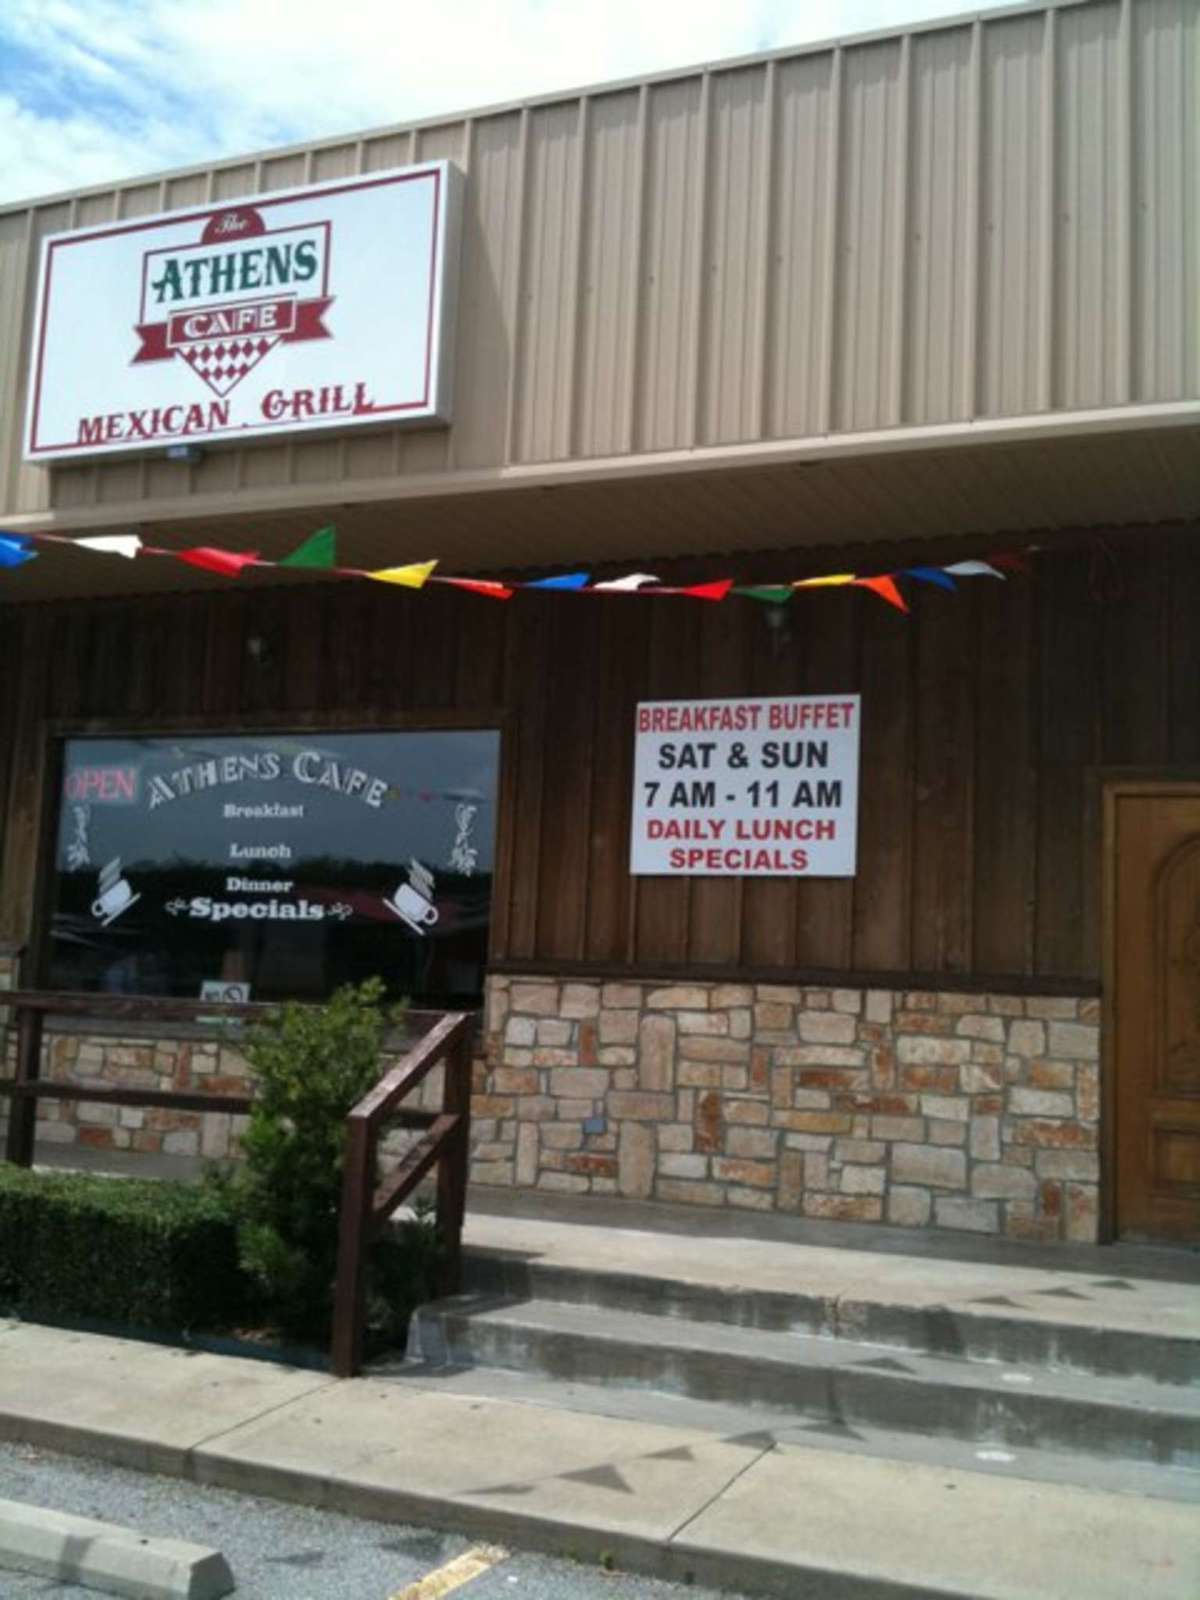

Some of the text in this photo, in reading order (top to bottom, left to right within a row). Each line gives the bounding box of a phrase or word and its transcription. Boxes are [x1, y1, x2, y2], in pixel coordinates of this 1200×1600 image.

[151, 239, 318, 303] ATHENS
[183, 304, 279, 340] CAFE
[78, 382, 376, 445] MEXICAN GRILL
[638, 702, 855, 733] BREAKFAST BUFFET
[658, 740, 829, 769] SAT & SUN
[65, 766, 136, 801] OPEN
[293, 750, 389, 808] CAFE
[644, 782, 661, 808] 7
[669, 782, 716, 808] AM
[747, 781, 780, 808] 11
[792, 781, 843, 808] AM
[223, 802, 305, 819] Breakfast
[647, 820, 836, 840] DAILY LUNCH
[229, 843, 292, 860] Lunch
[669, 849, 808, 870] SPECIALS
[226, 876, 295, 894] Dinner
[188, 898, 325, 922] Specials
